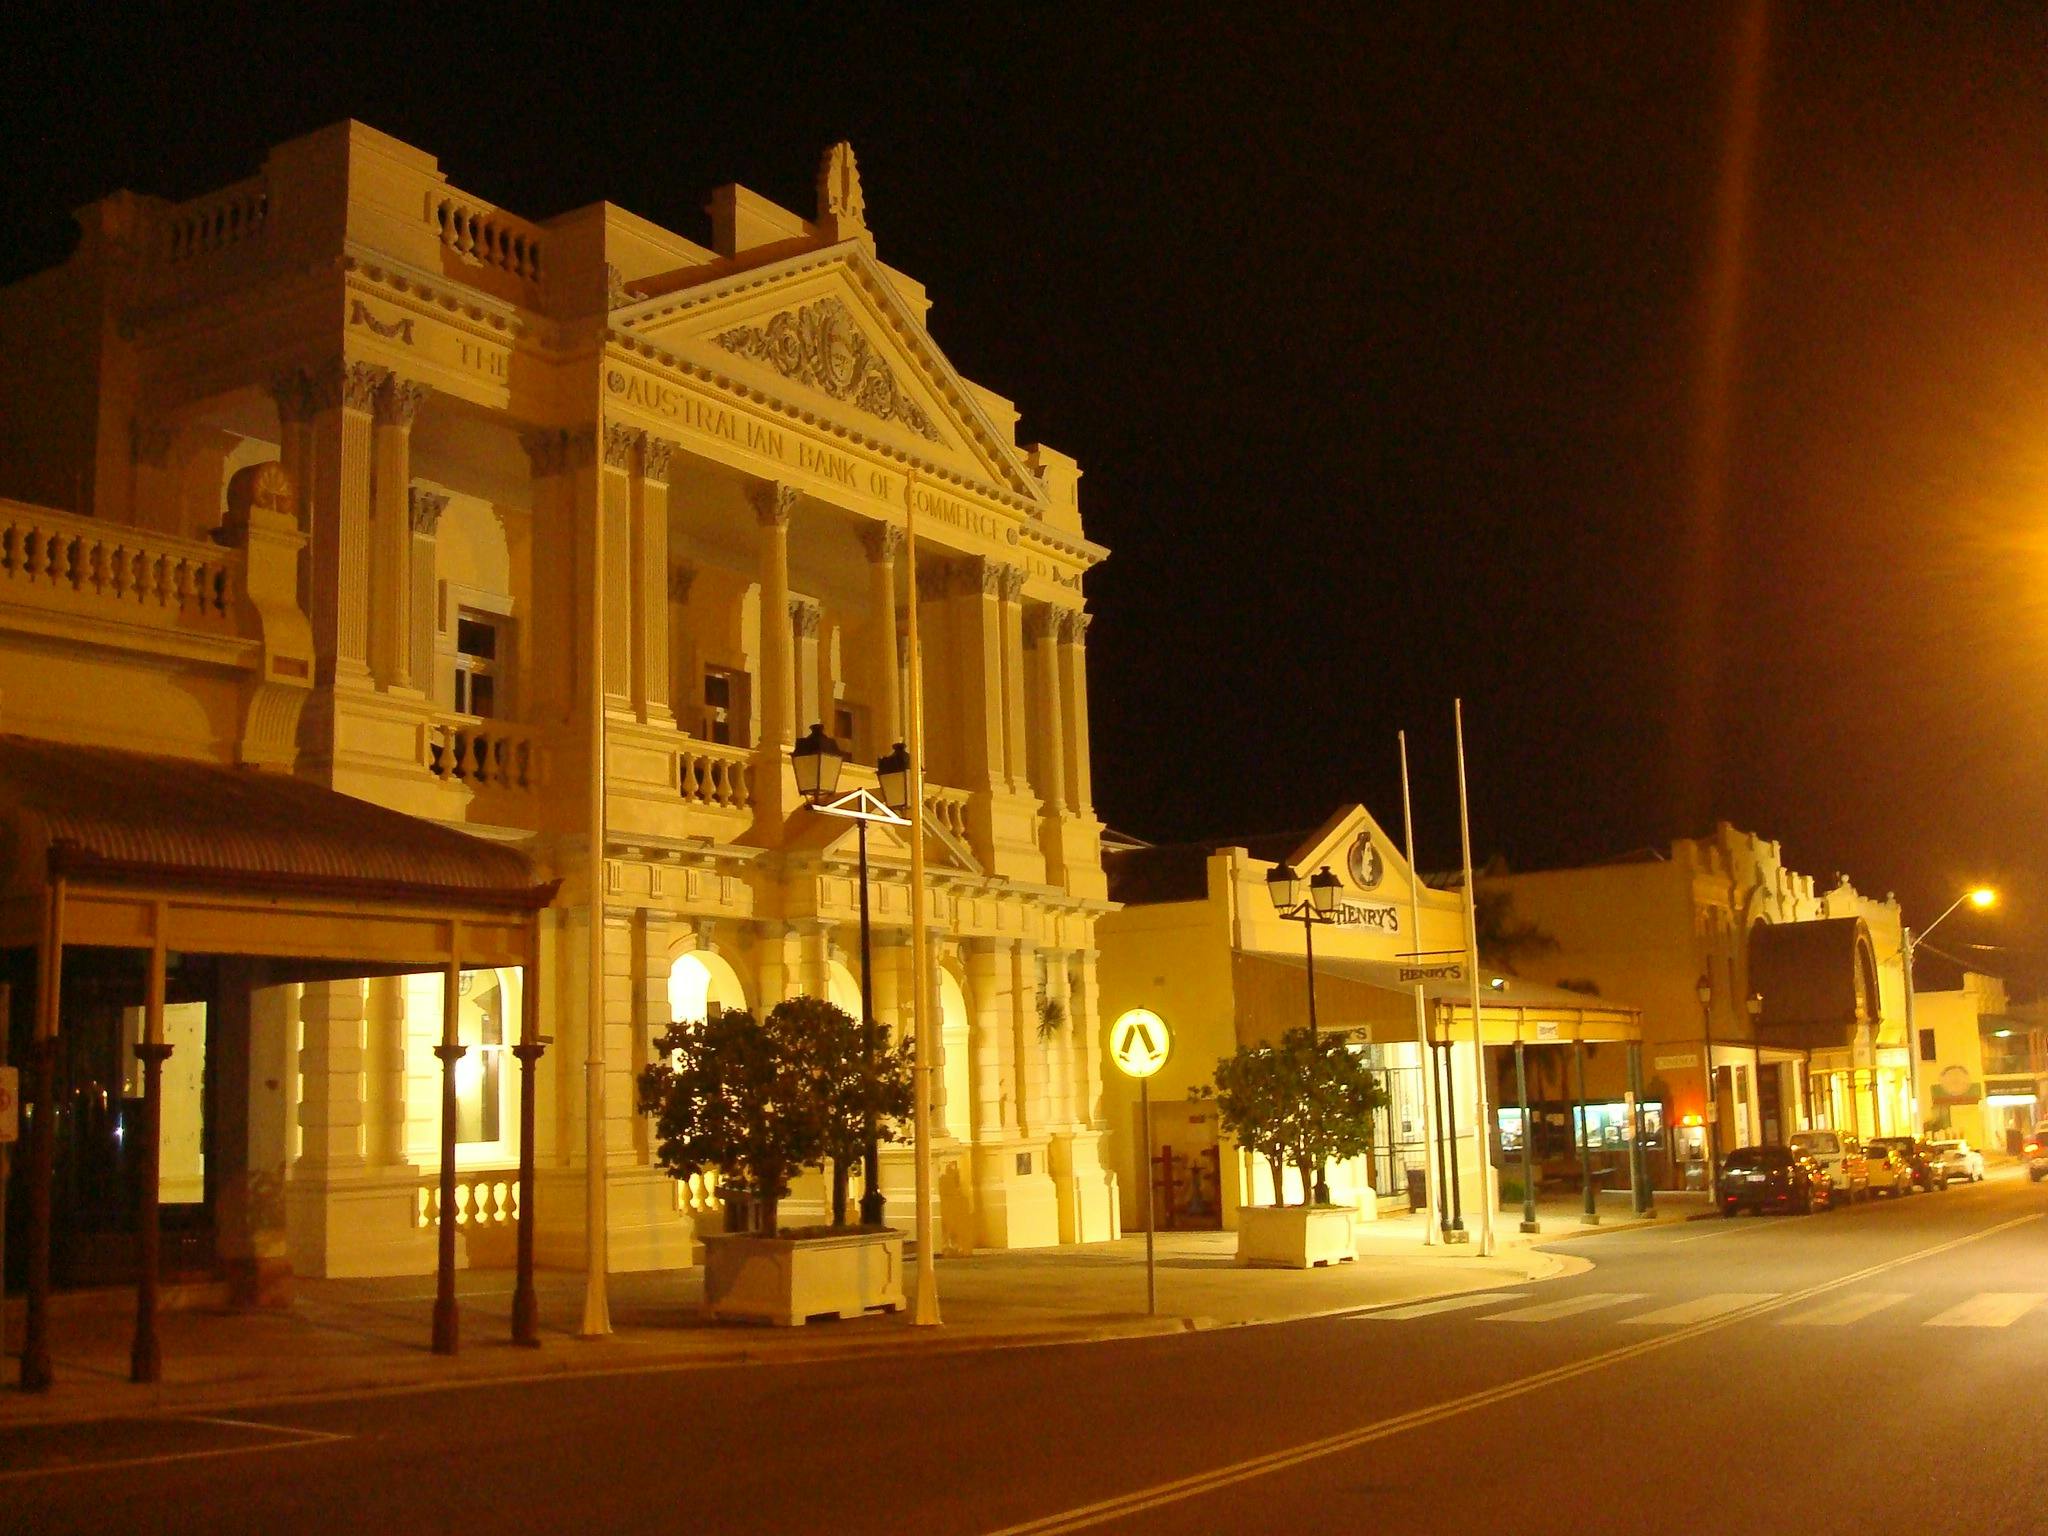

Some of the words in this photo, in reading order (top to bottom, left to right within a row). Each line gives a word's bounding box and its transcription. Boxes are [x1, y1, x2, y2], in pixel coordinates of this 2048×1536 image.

[626, 375, 785, 459] AUSTRALIAN
[799, 442, 857, 488] BANK
[870, 470, 896, 500] OF
[1336, 902, 1398, 931] HENRY'S
[1399, 965, 1461, 982] HENRY'S
